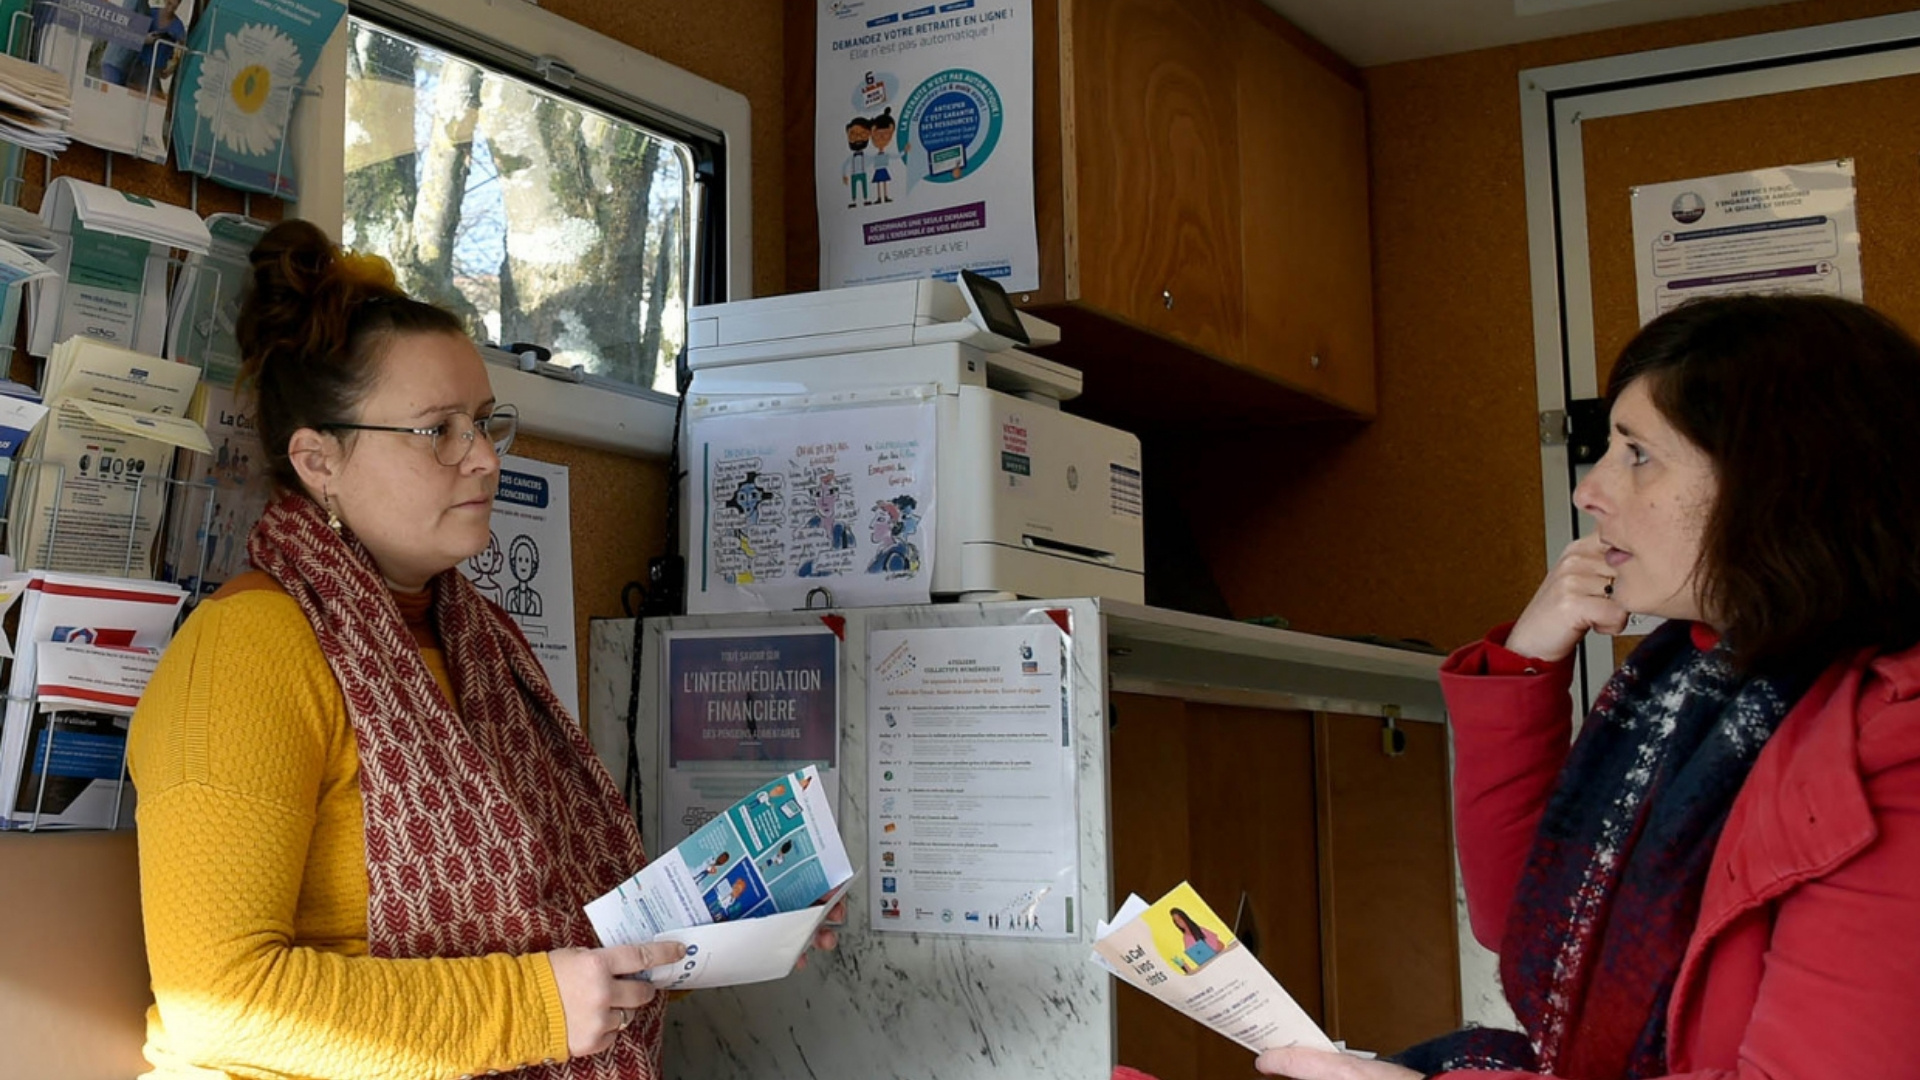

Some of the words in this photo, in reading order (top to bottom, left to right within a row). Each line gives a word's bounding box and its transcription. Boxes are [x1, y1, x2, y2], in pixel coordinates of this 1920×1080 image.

[100, 6, 111, 21] LE
[111, 12, 131, 27] LIEN
[832, 32, 881, 51] DEMANDEZ
[884, 26, 914, 41] VOTRE
[916, 19, 961, 35] RETRAITE
[964, 15, 977, 26] EN
[979, 9, 1008, 23] LIGNE
[849, 47, 868, 61] Elle
[871, 43, 895, 57] n'est
[898, 39, 918, 55] pas
[919, 26, 988, 47] automatique
[864, 70, 875, 85] 6
[903, 86, 928, 121] RETRAITE
[949, 71, 963, 82] PAS
[868, 233, 885, 243] POUR
[886, 226, 926, 240] L'ENSEMBLE
[927, 225, 935, 235] DE
[936, 223, 950, 233] VOS
[950, 219, 980, 232] RÉGIMES
[869, 221, 907, 234] DÉSORMAIS
[908, 218, 921, 229] UNE
[922, 215, 943, 226] SEULE
[944, 210, 977, 223] DEMANDE
[891, 245, 932, 261] SIMPLIFIE
[935, 244, 946, 255] LA
[948, 242, 964, 253] VIE
[220, 409, 235, 427] La
[501, 474, 512, 485] DES
[513, 476, 542, 490] CANCERS
[500, 488, 534, 503] CONCERNE
[721, 651, 738, 662] TOUT
[739, 650, 765, 661] SAVOIR
[766, 649, 781, 661] SUR
[683, 665, 821, 693] L'INTERMÉDIATION
[707, 693, 797, 722] FINANCIÈRE
[702, 728, 716, 739] DES
[717, 728, 751, 739] PENSIONS
[1137, 959, 1156, 974] vos
